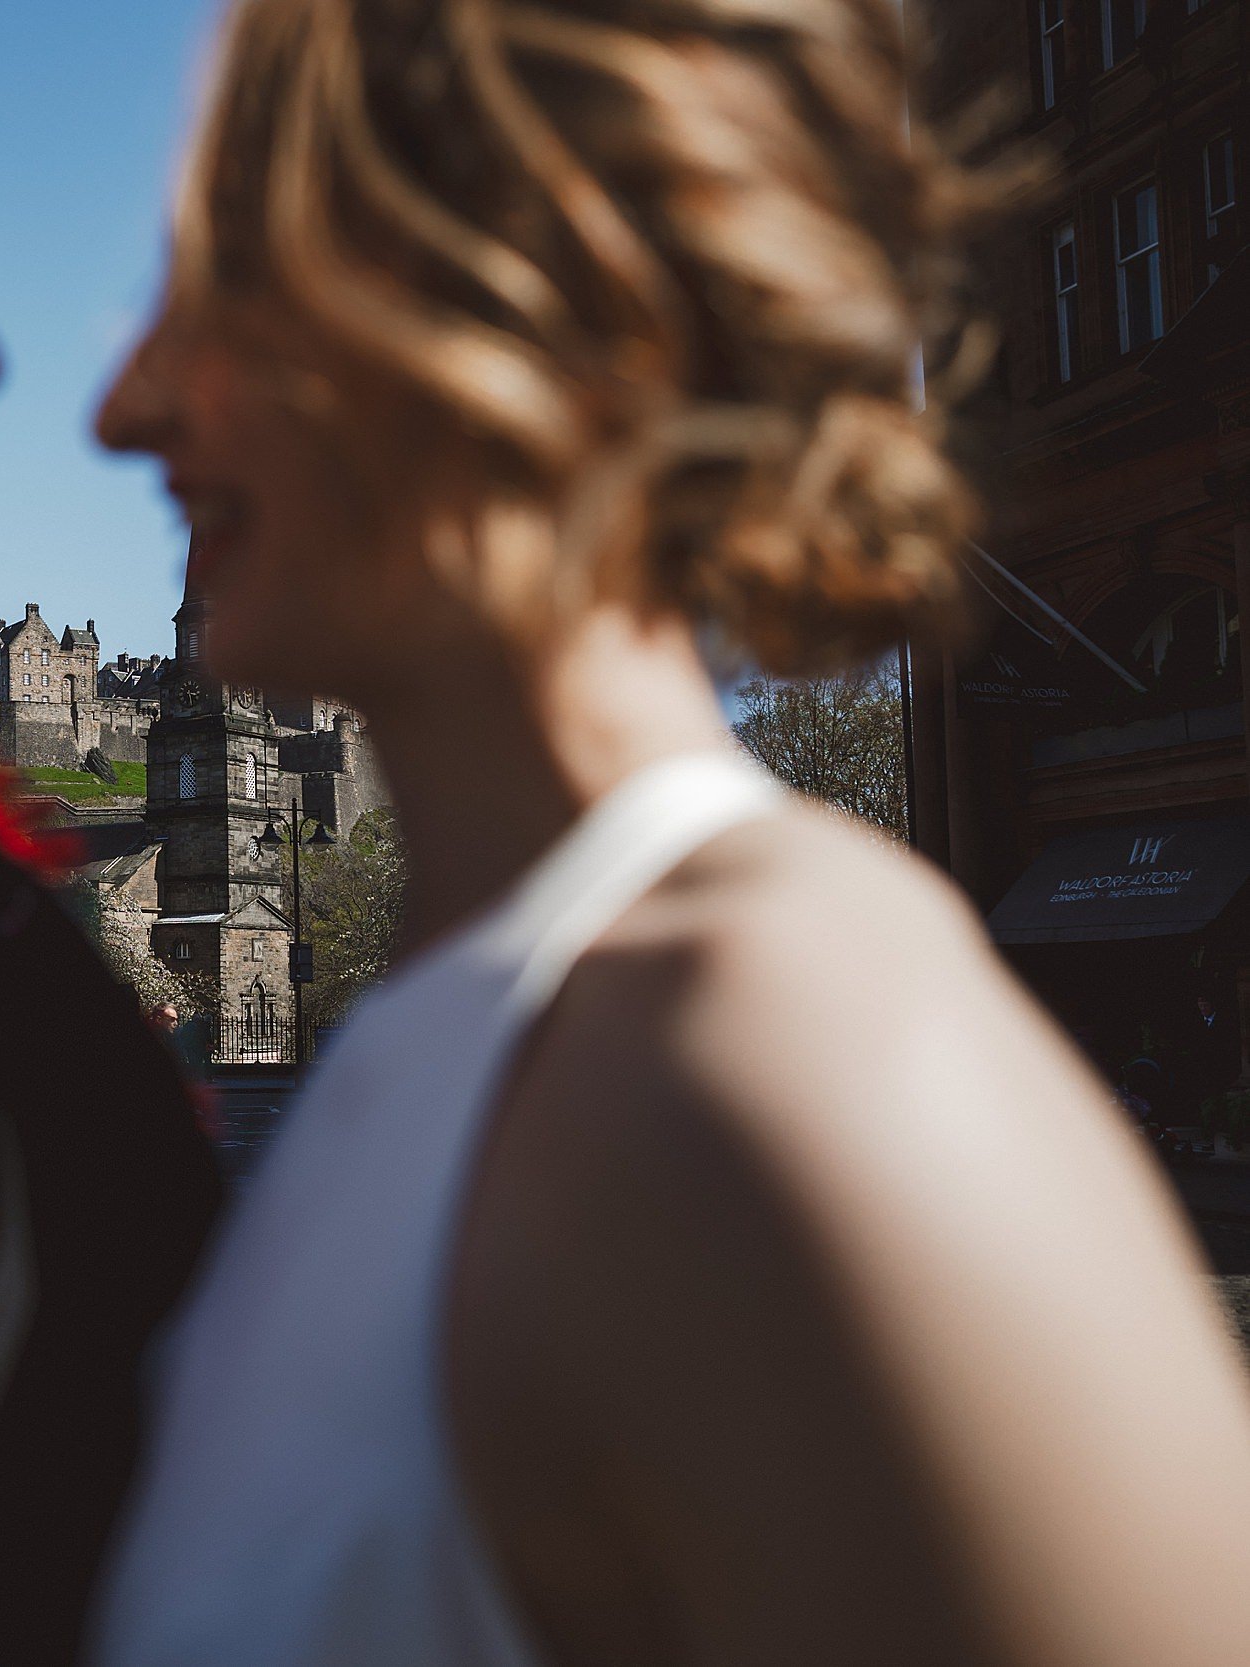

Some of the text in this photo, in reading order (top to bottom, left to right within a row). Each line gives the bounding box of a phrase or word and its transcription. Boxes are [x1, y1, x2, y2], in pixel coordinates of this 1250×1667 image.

[961, 682, 1070, 698] WALDORF ASTORIA
[1058, 870, 1193, 890] WALDORF ASTORIA
